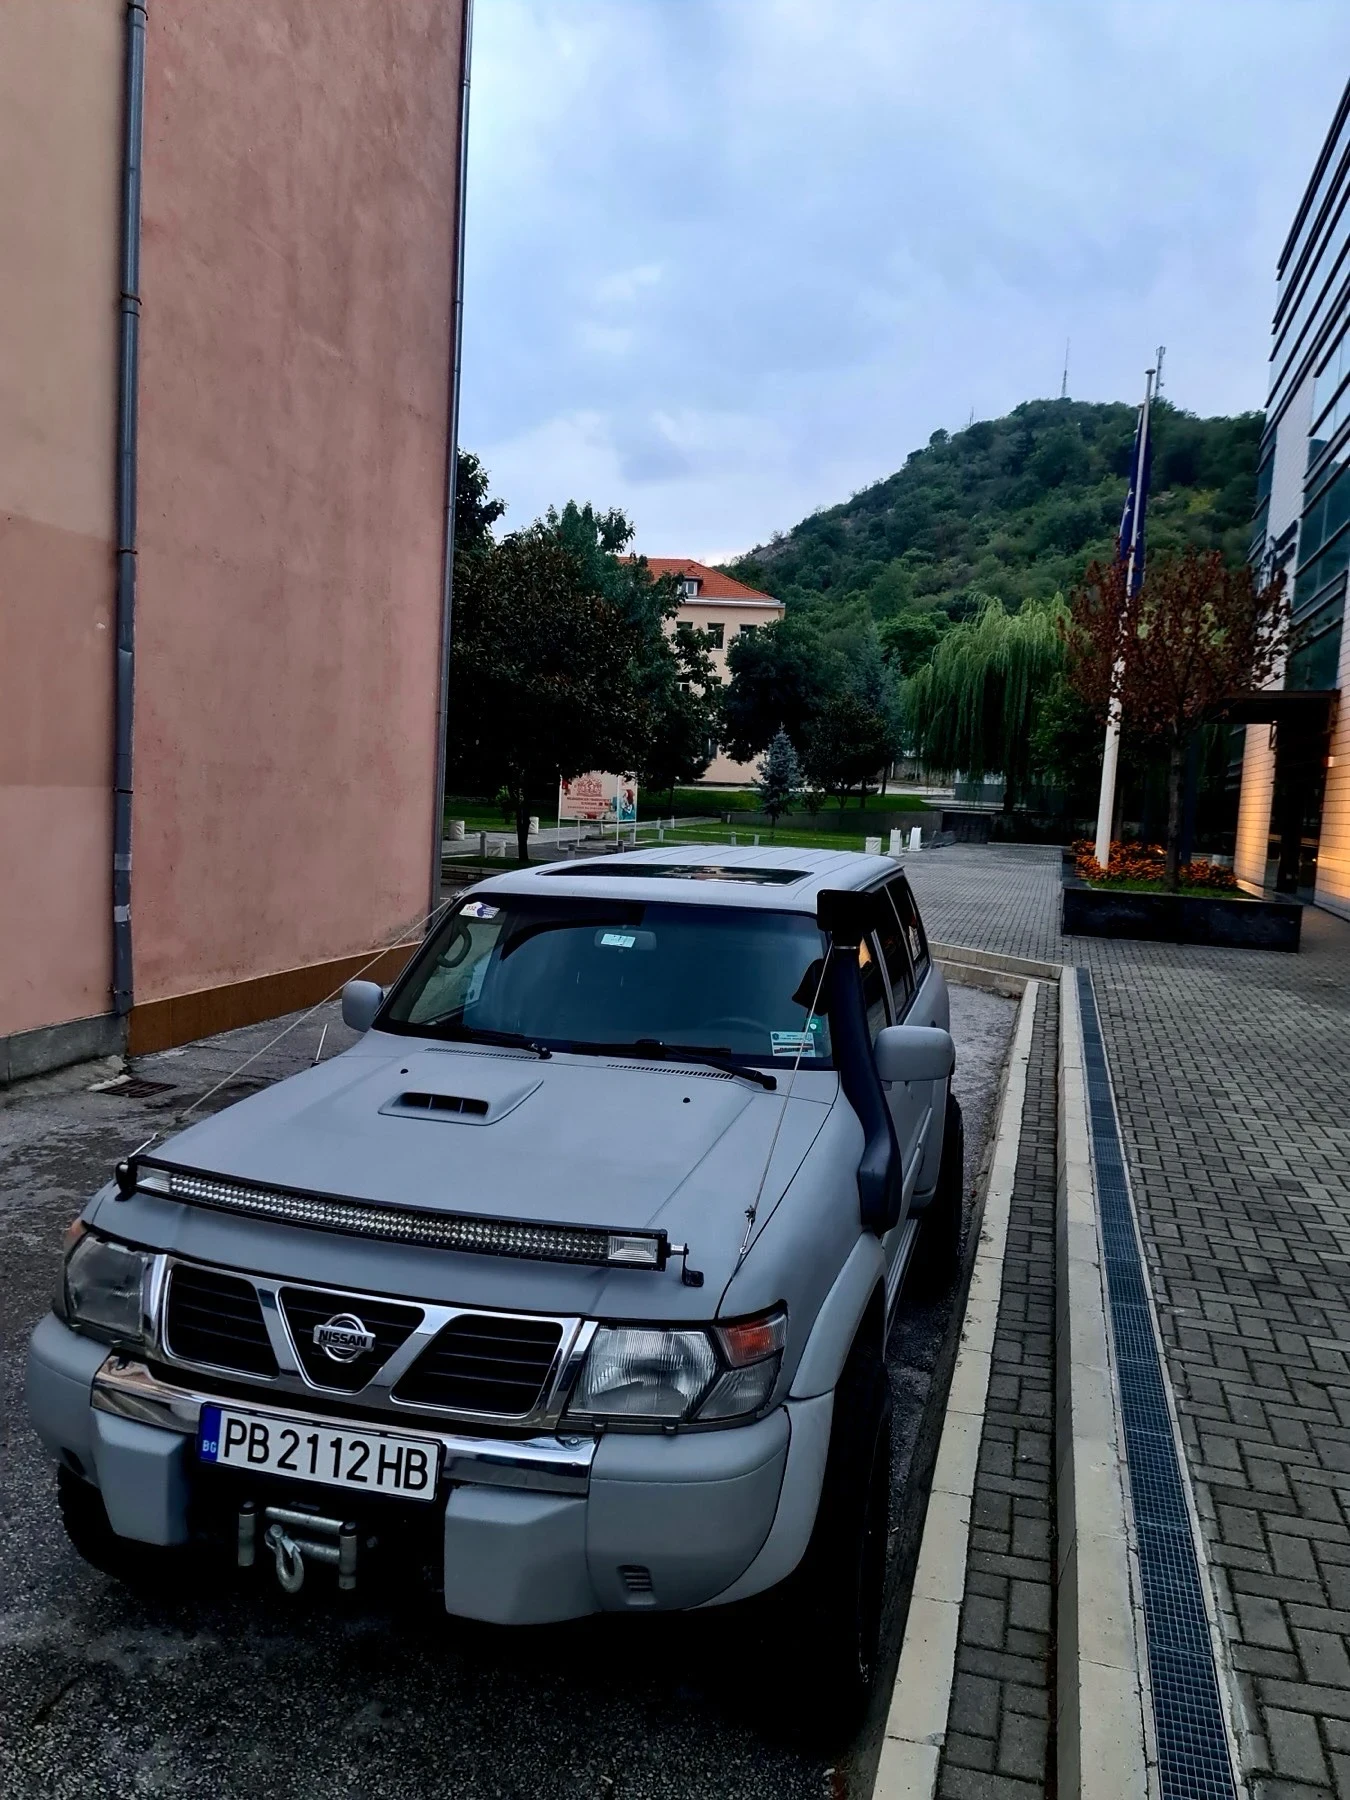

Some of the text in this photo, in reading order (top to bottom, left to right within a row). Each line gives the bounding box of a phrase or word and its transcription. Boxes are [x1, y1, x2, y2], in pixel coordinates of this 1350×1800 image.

[319, 1330, 367, 1347] NISSAN
[202, 1439, 217, 1454] BG
[224, 1418, 428, 1491] PB 2112 HB
